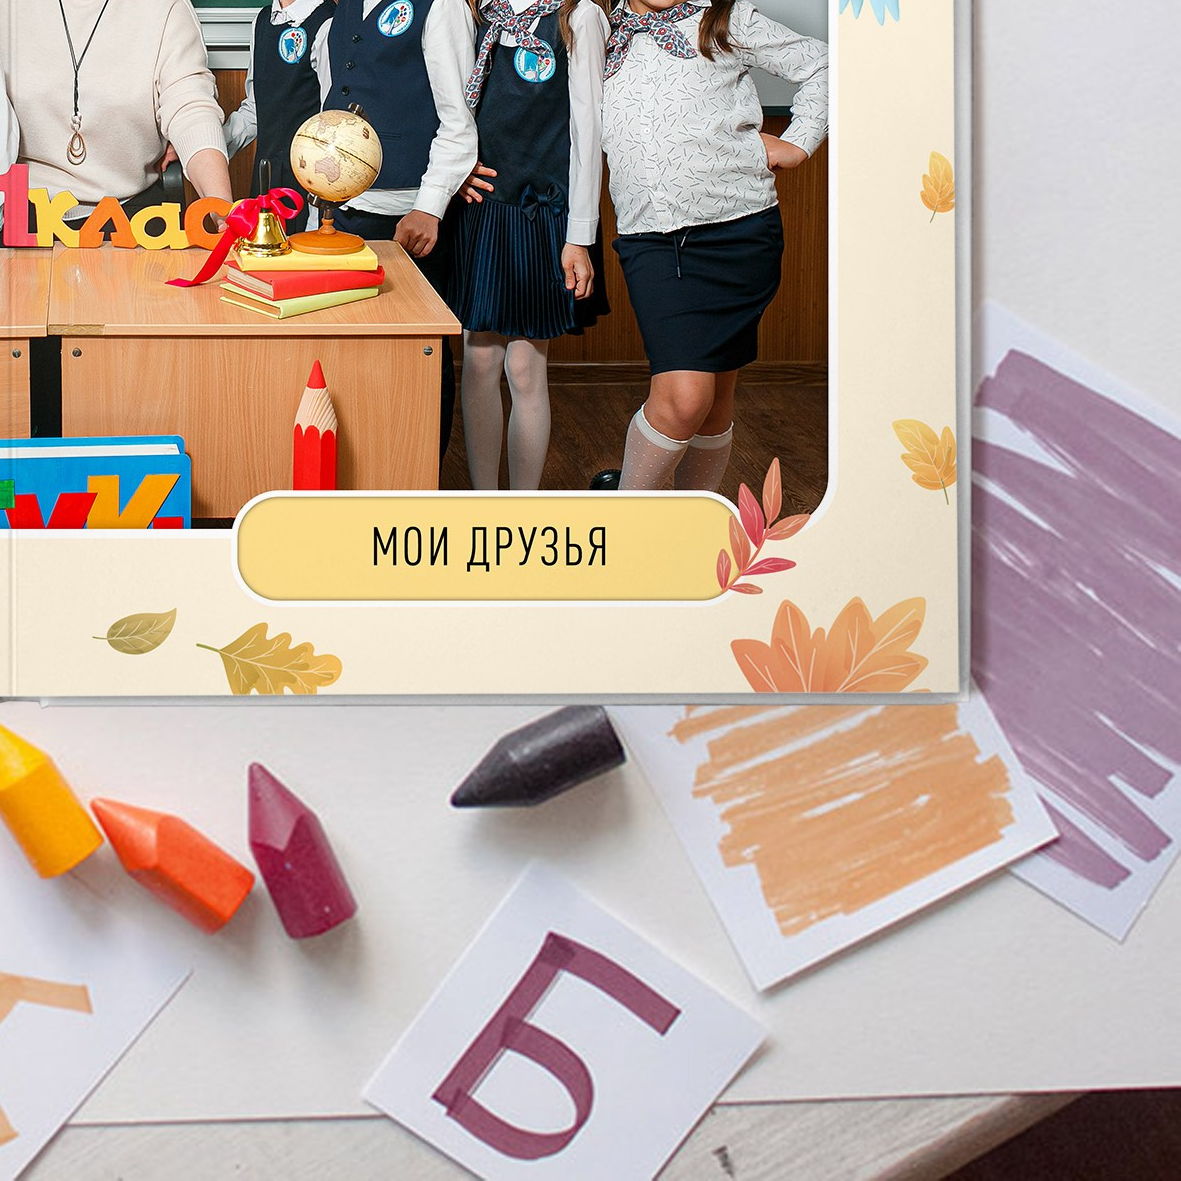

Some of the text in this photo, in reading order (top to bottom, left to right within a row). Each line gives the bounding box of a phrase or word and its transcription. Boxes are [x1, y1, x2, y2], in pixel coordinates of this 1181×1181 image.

[372, 525, 608, 573] МОИ ДРУЗЬЯ
[430, 930, 682, 1161] Б
